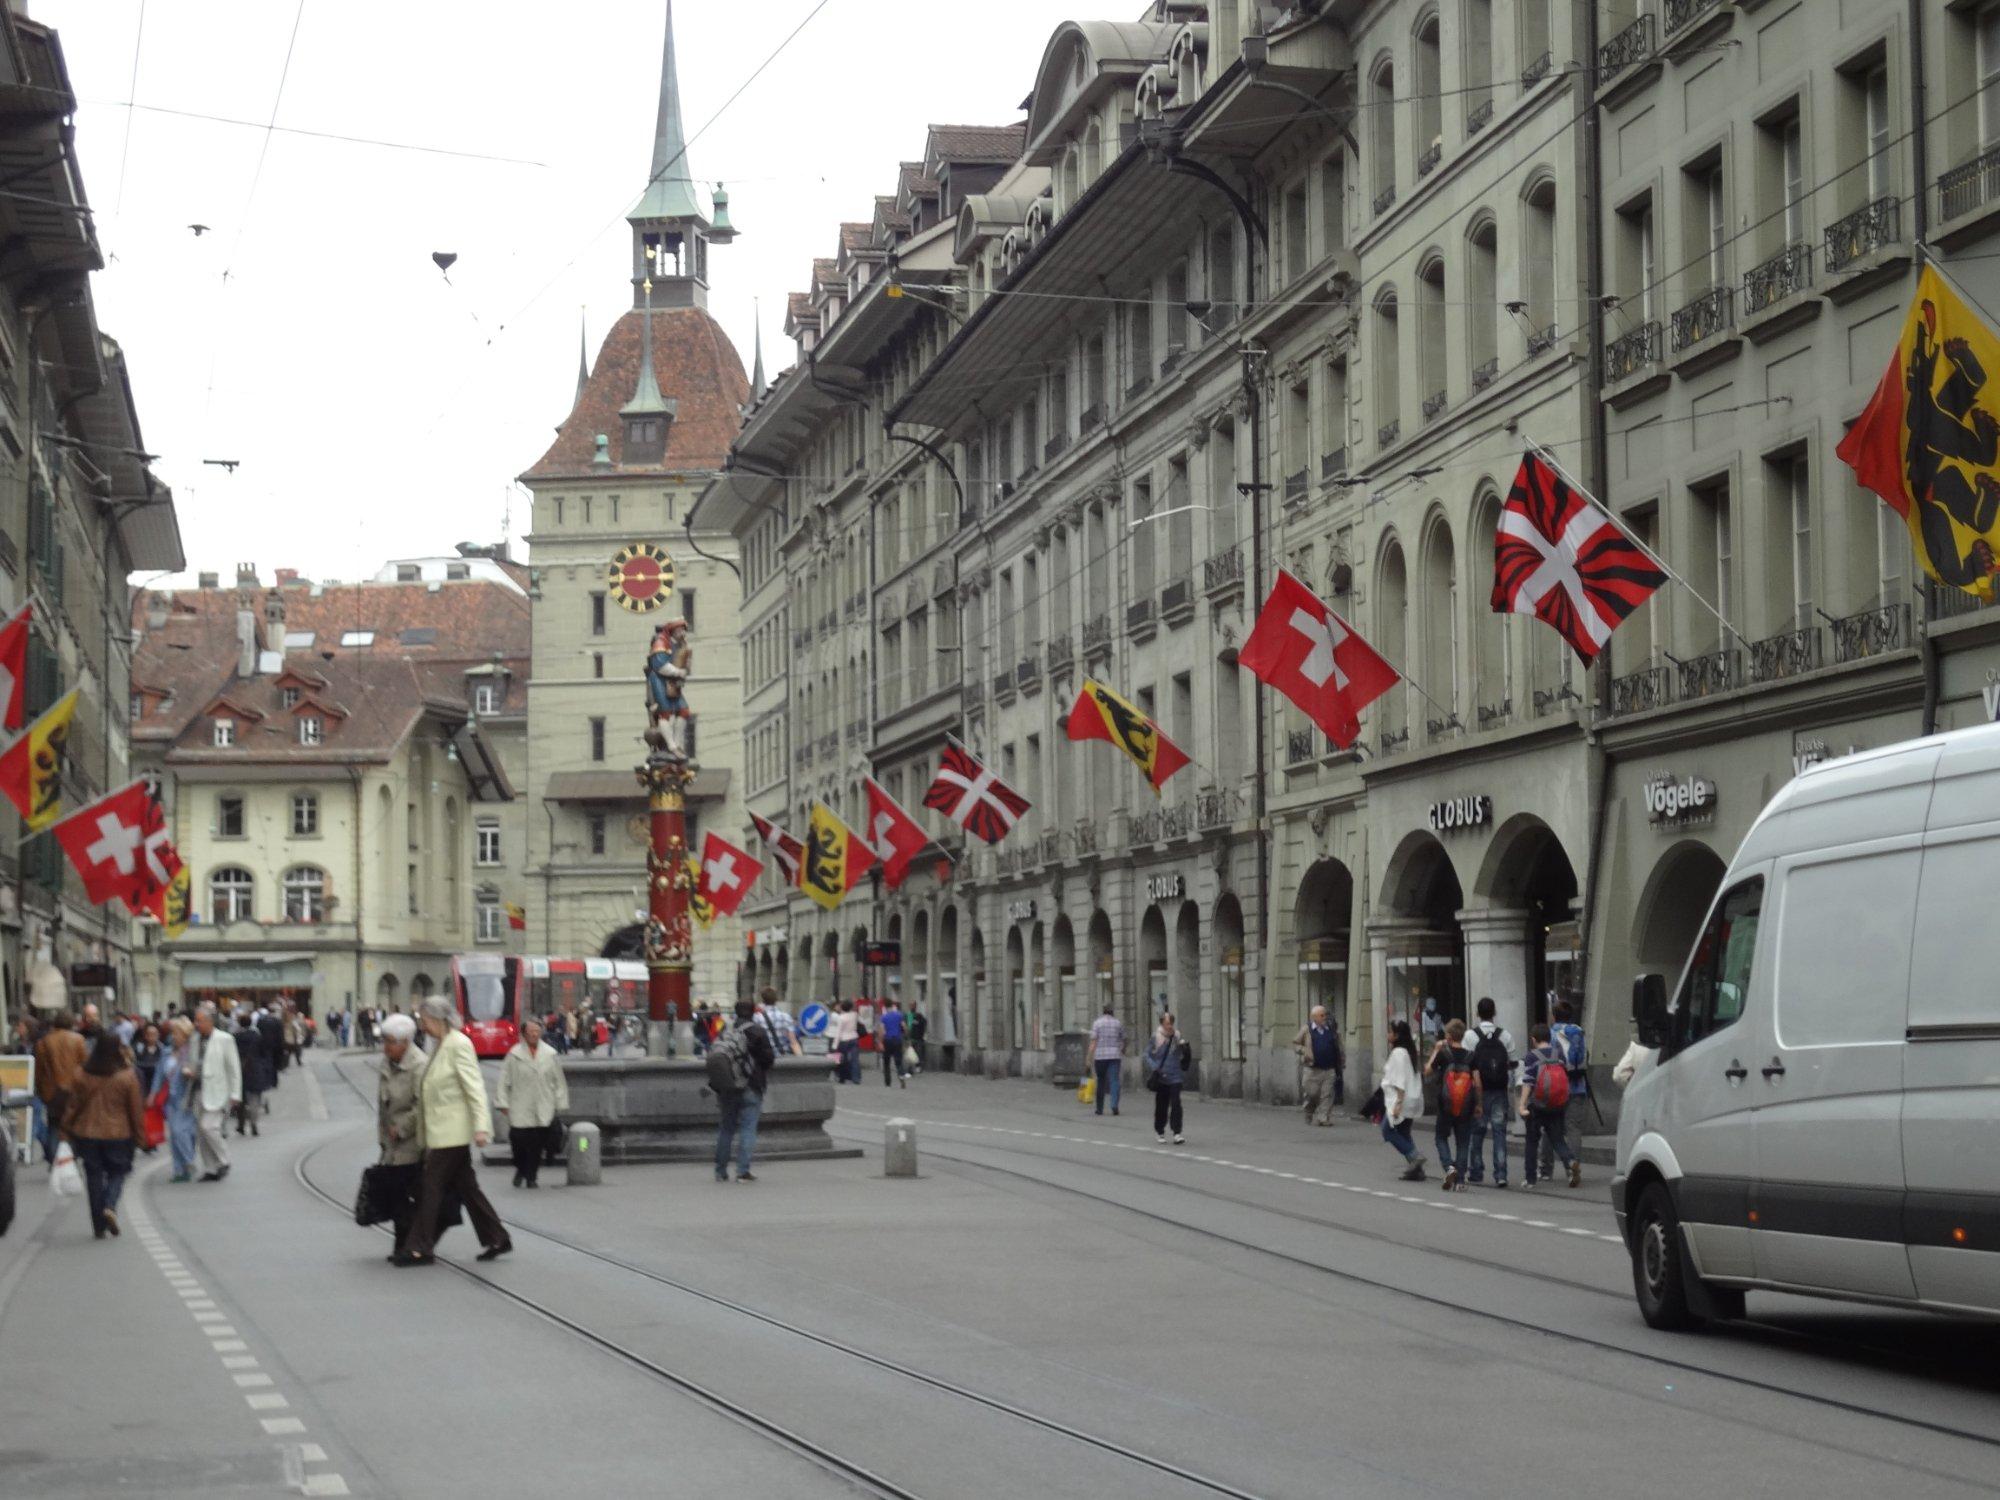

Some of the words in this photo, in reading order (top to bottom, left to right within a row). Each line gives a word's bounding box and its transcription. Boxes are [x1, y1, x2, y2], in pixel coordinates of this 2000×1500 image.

[1428, 795, 1483, 830] GLOBUS
[1644, 776, 1706, 817] Vögele
[1146, 875, 1179, 900] GLOBUS
